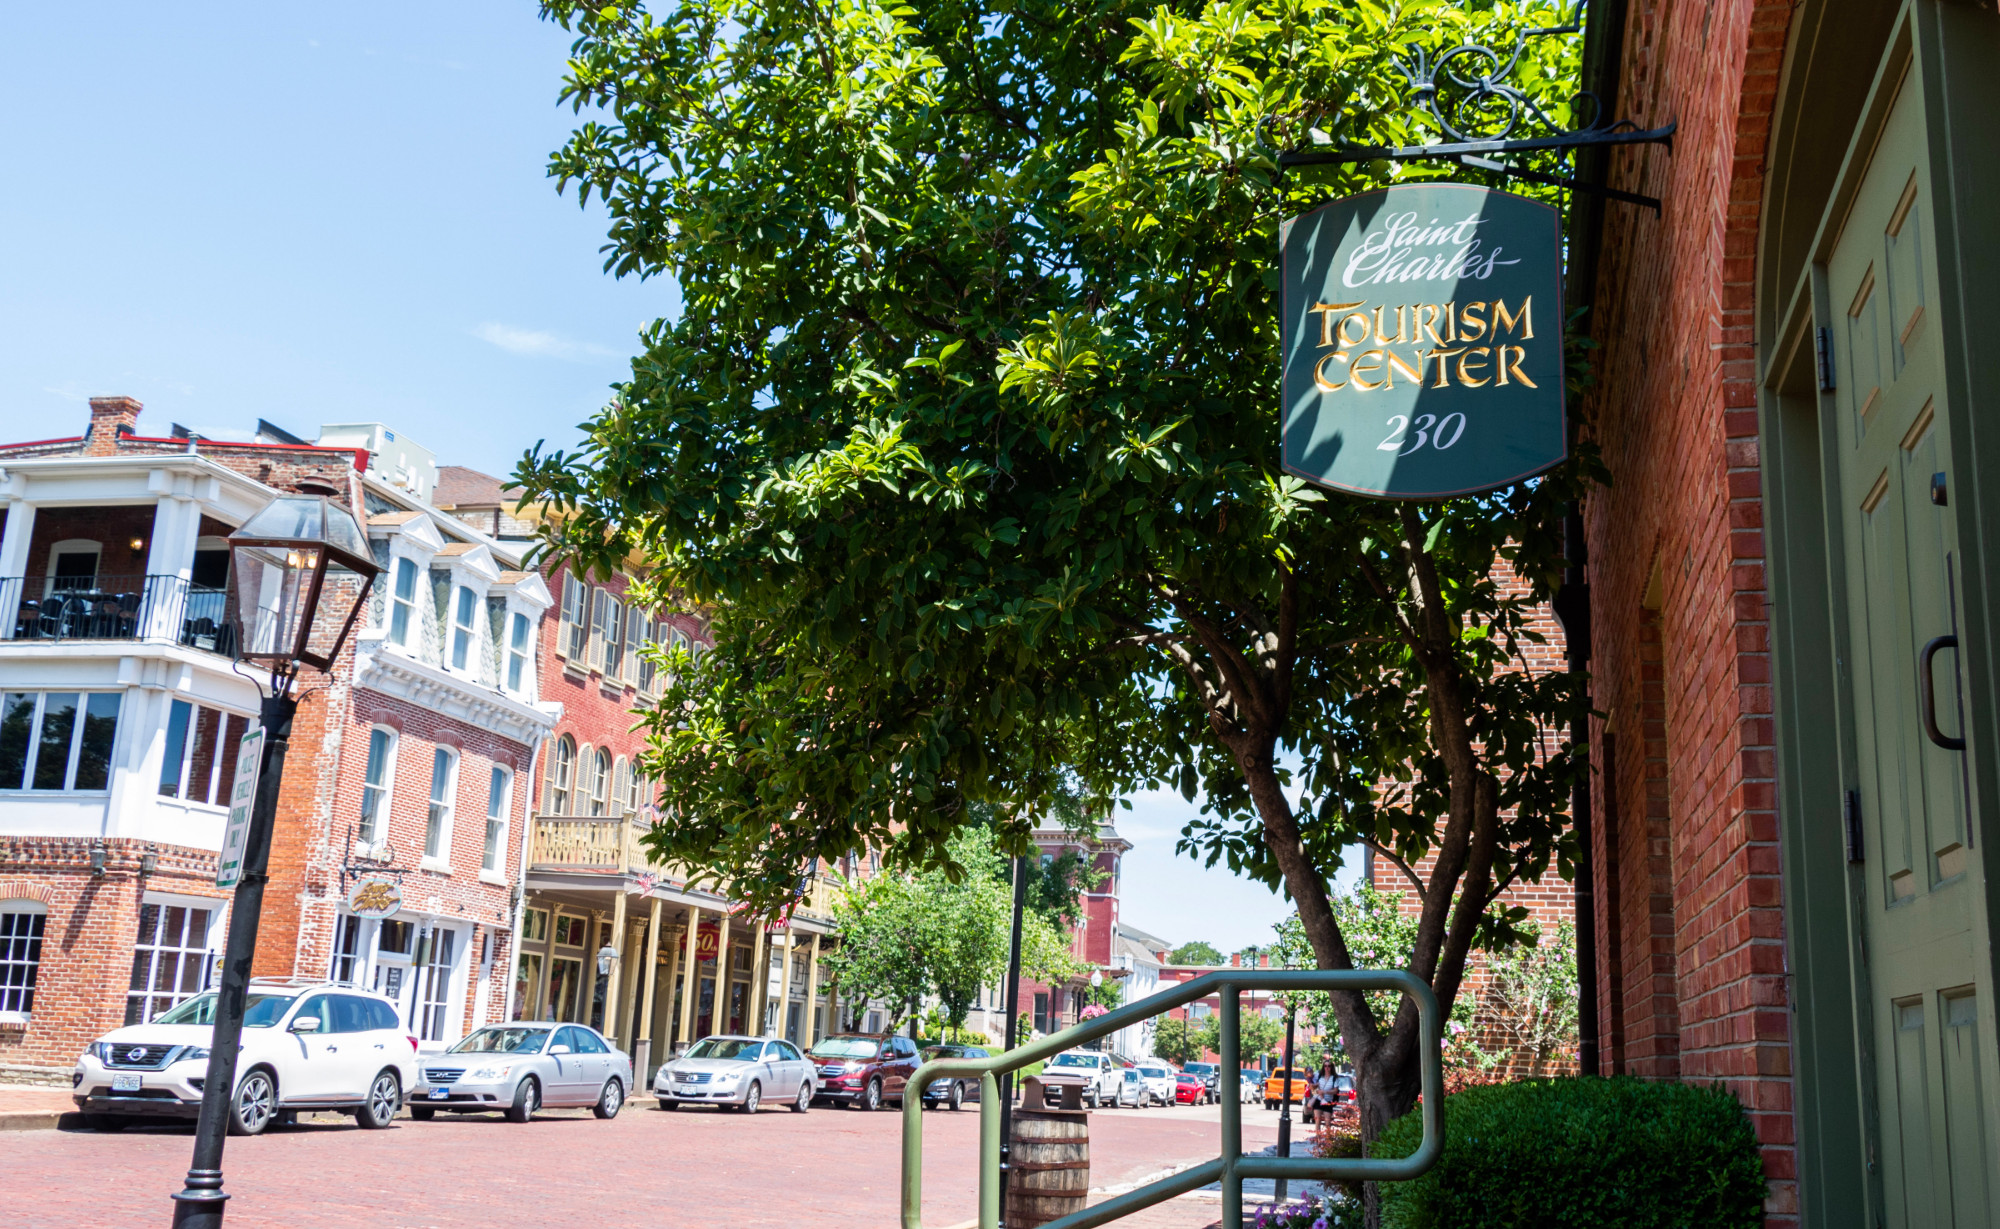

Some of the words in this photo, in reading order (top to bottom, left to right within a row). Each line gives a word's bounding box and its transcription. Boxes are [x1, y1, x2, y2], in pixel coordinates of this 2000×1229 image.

[1365, 211, 1489, 249] Saint
[1342, 239, 1521, 288] Charles
[1308, 295, 1534, 348] TOURISM
[1313, 344, 1538, 393] CENTER
[1376, 412, 1466, 457] 230
